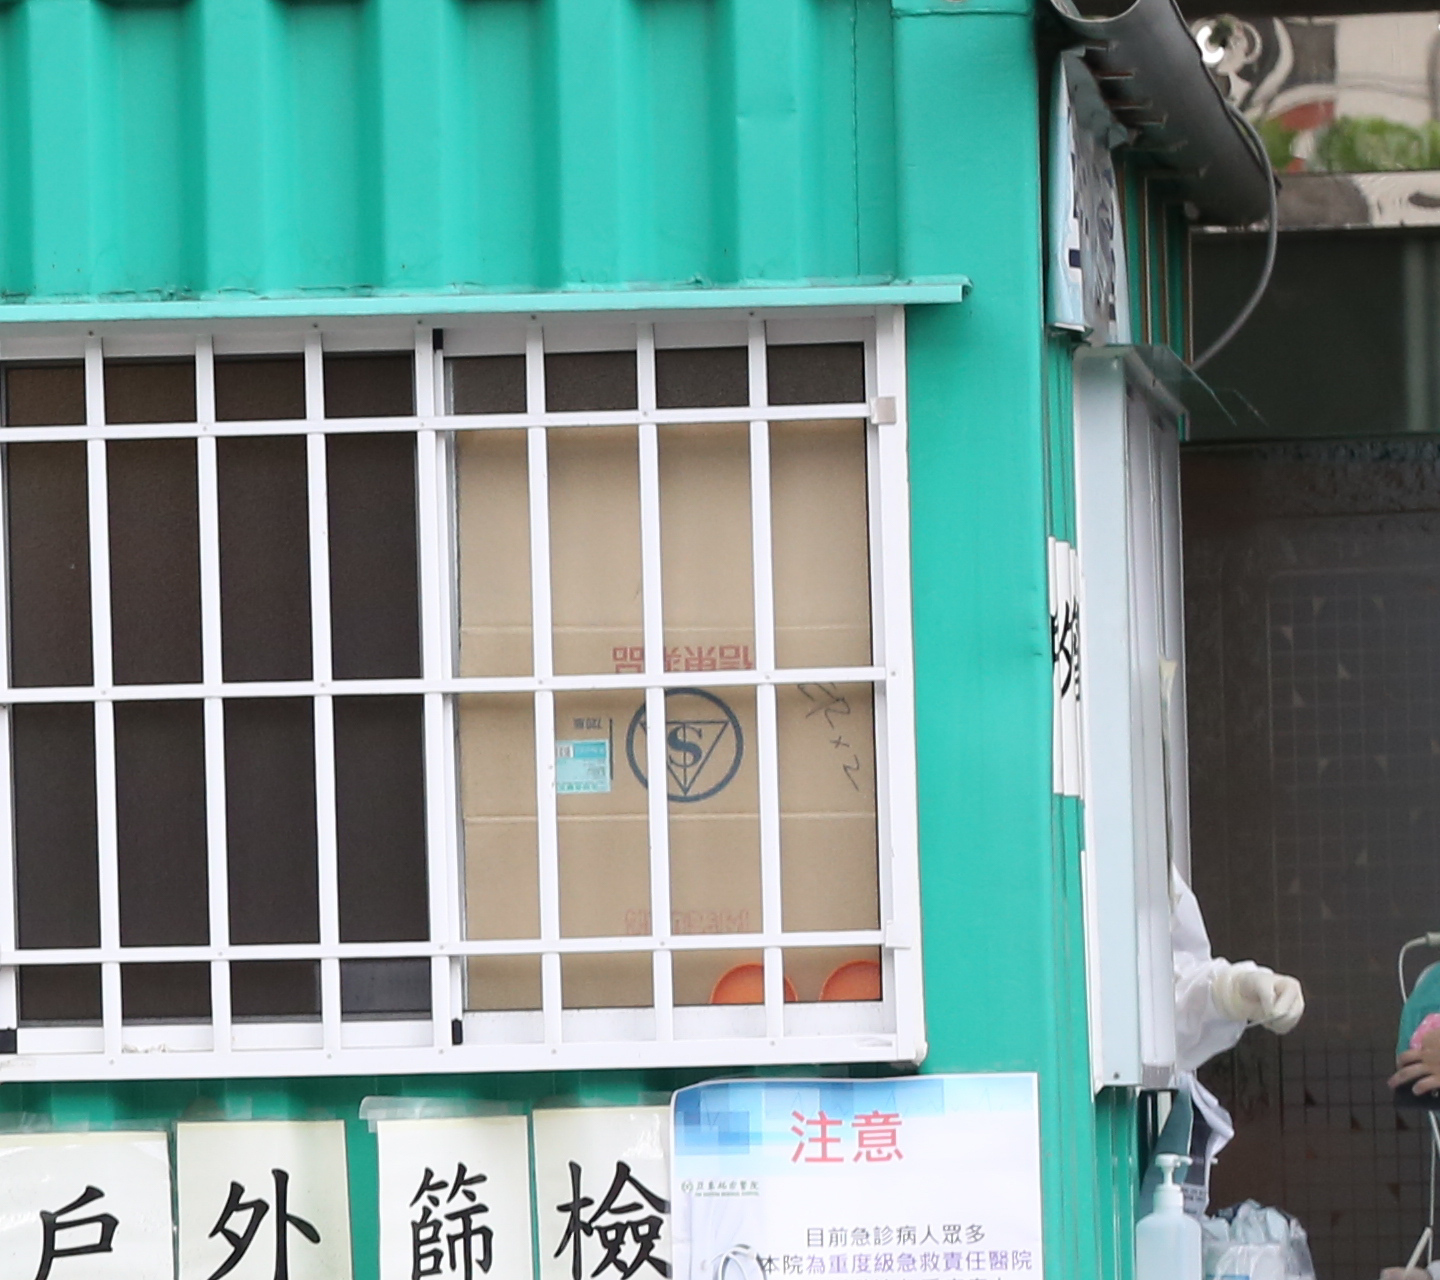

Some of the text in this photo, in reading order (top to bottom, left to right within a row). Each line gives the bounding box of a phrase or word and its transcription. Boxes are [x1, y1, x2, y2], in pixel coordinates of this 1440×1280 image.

[790, 1109, 904, 1164] 注意
[805, 1223, 986, 1248] 目前急診病人眾多
[761, 1249, 1033, 1276] 本院為重度級急救責任醫院
